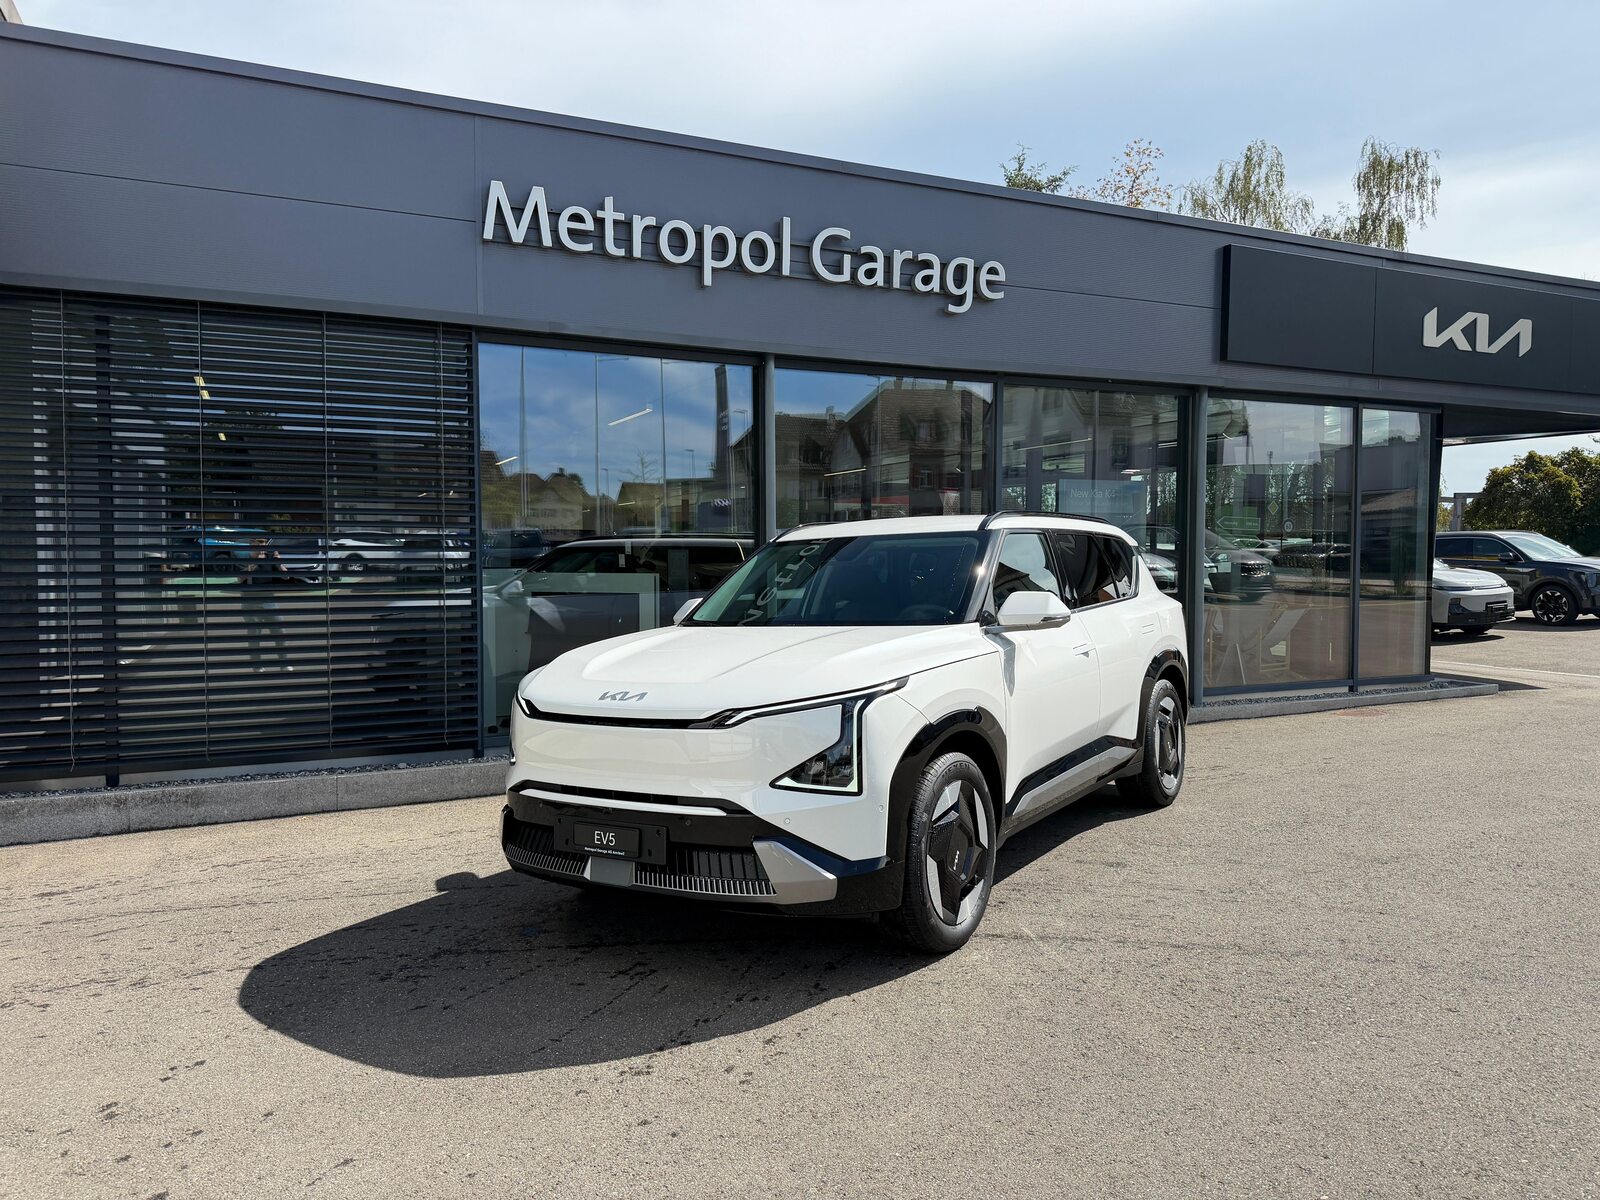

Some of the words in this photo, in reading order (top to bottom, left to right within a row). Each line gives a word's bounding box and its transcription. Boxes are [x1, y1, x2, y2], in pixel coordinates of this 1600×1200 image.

[482, 180, 791, 287] Metropol
[809, 226, 1006, 314] Garage
[1423, 306, 1532, 357] KIA
[598, 690, 648, 702] KIA
[594, 830, 616, 846] EV5
